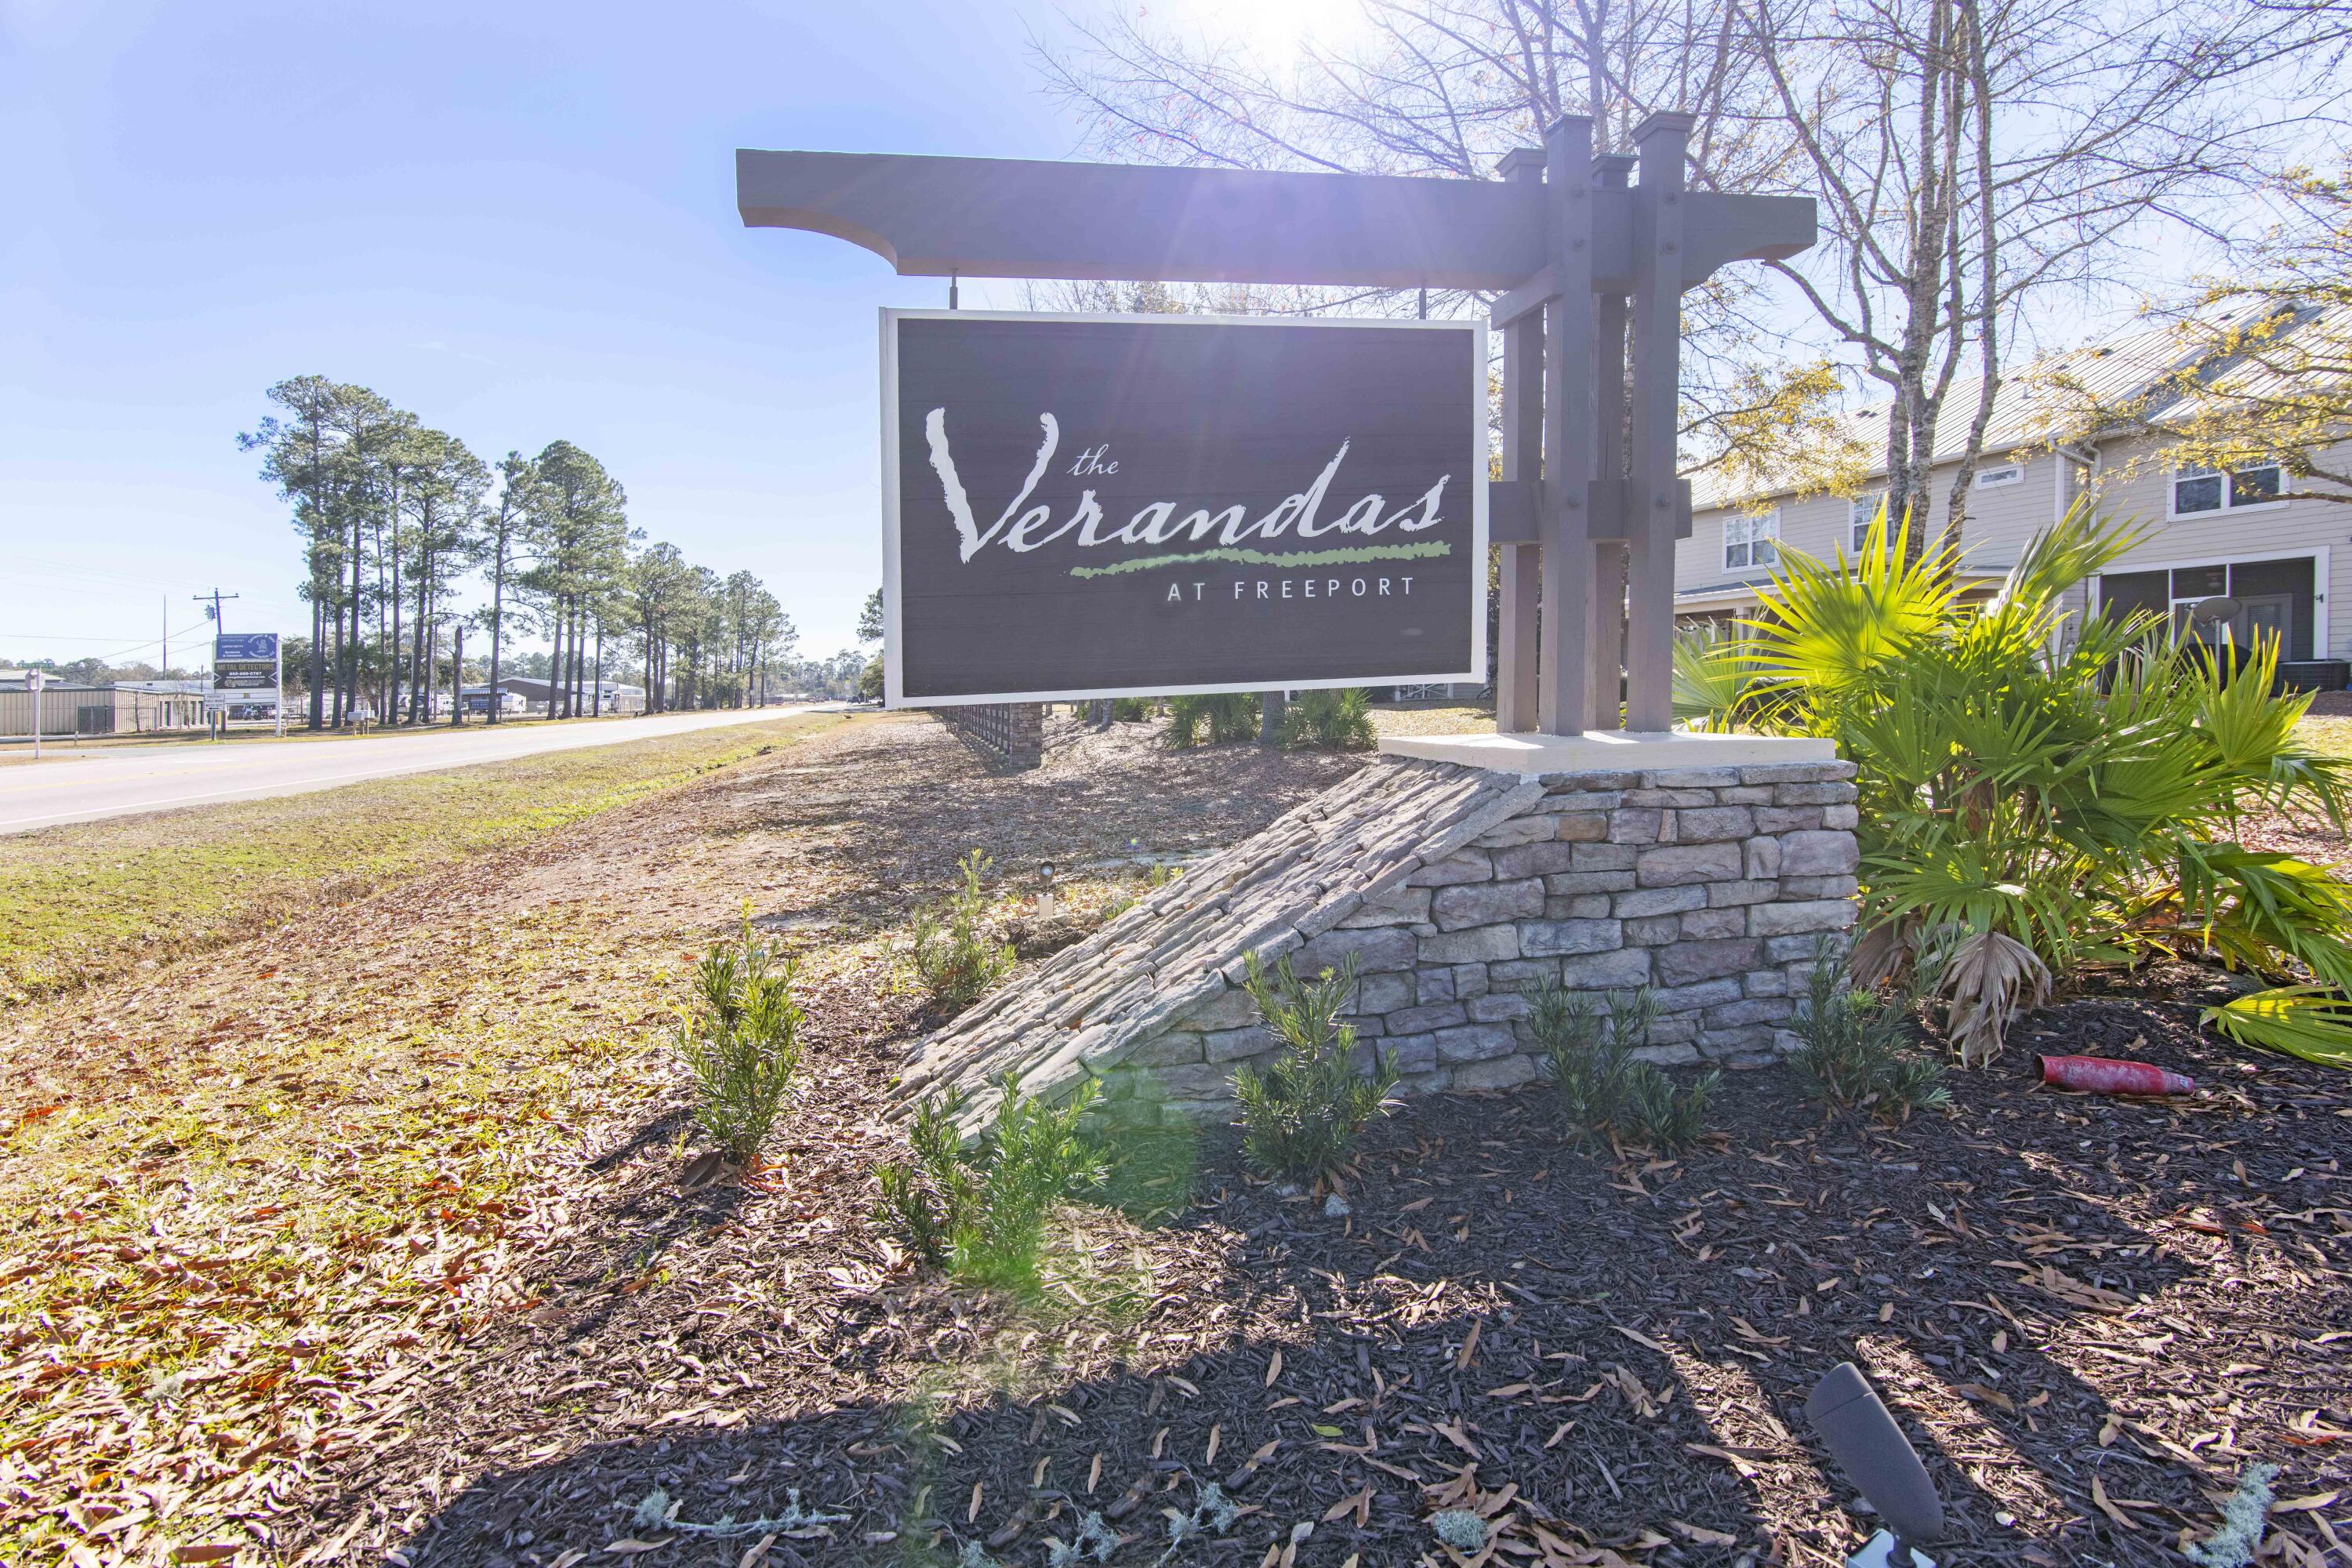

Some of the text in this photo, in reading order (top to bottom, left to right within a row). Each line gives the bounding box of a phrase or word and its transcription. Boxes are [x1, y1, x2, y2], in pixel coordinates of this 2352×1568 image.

[1067, 443, 1120, 476] the
[925, 406, 1452, 565] Verandas
[1167, 577, 1414, 601] AT FREEPORT
